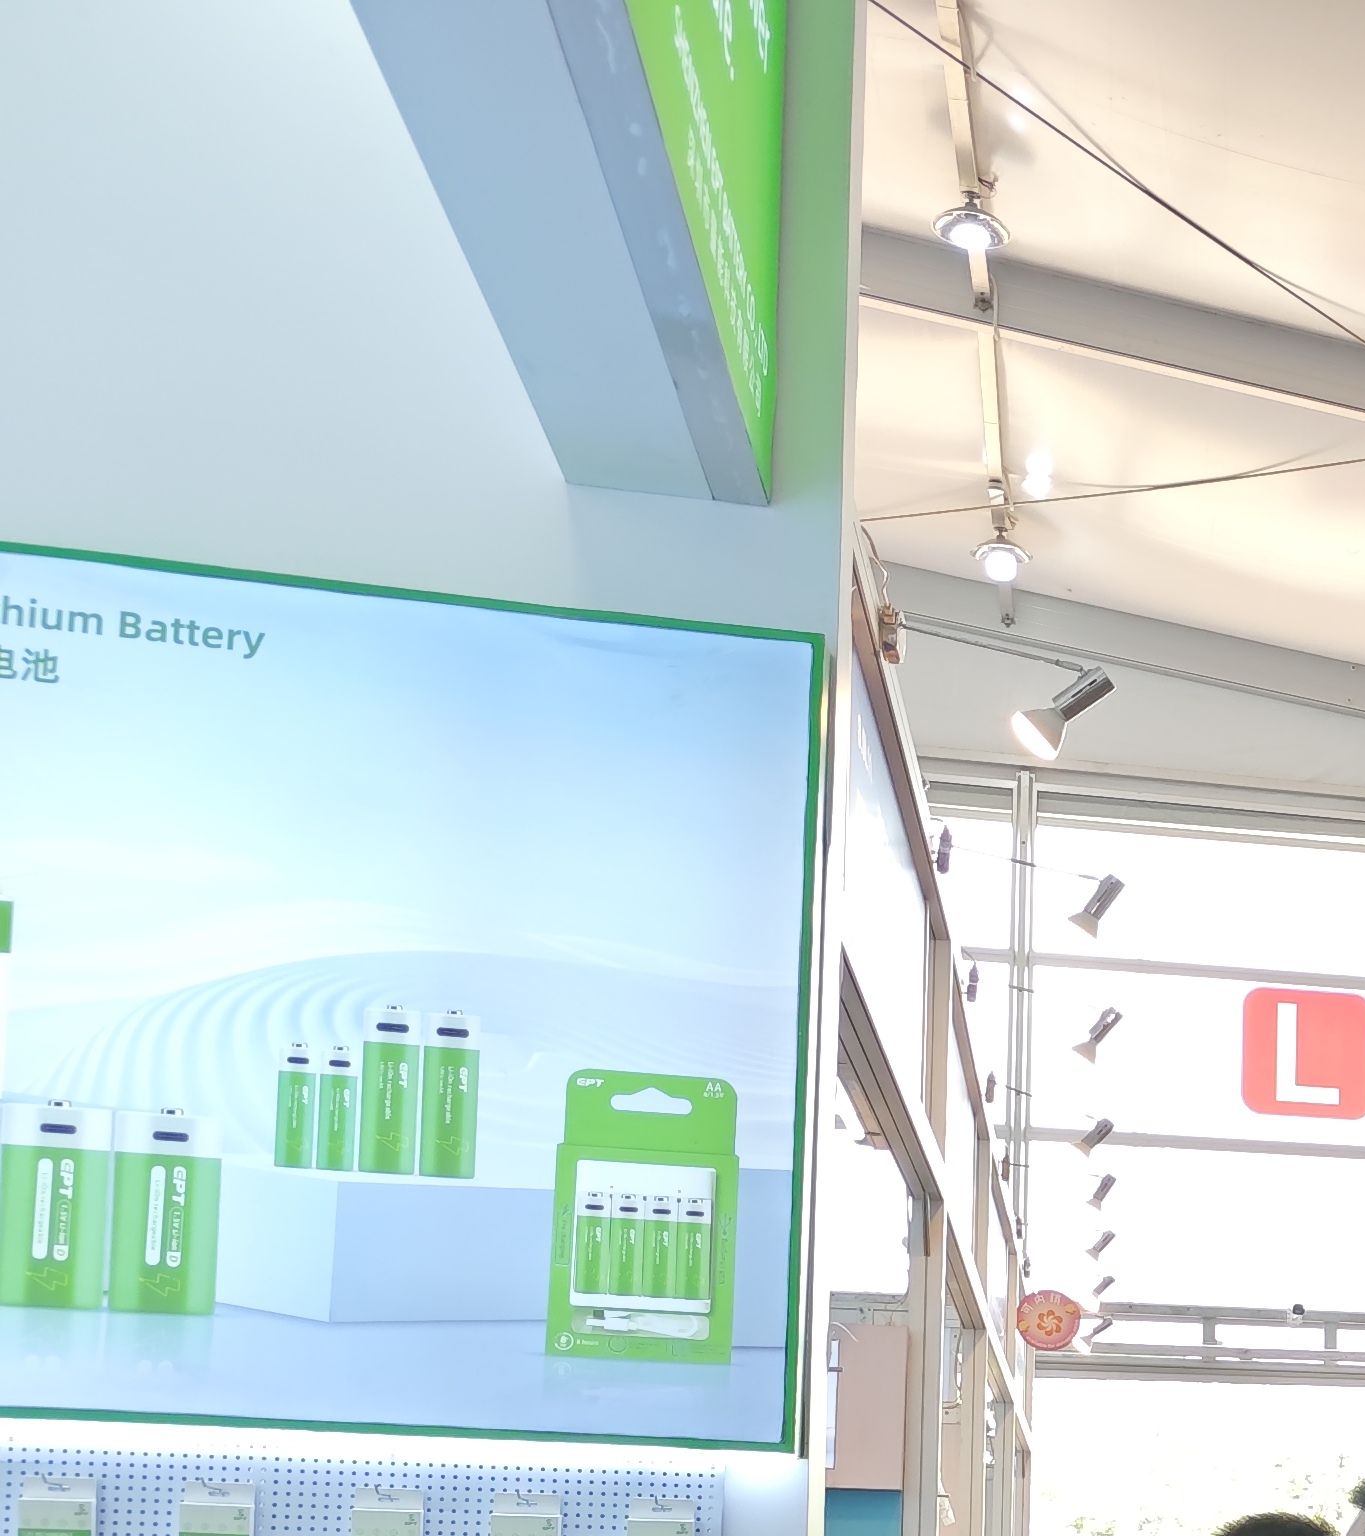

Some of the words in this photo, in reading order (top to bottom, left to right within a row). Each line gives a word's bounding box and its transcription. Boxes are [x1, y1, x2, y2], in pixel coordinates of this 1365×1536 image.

[1, 595, 104, 636] hium
[118, 610, 266, 660] Battery
[1275, 1001, 1340, 1105] L
[705, 1081, 722, 1092] AA
